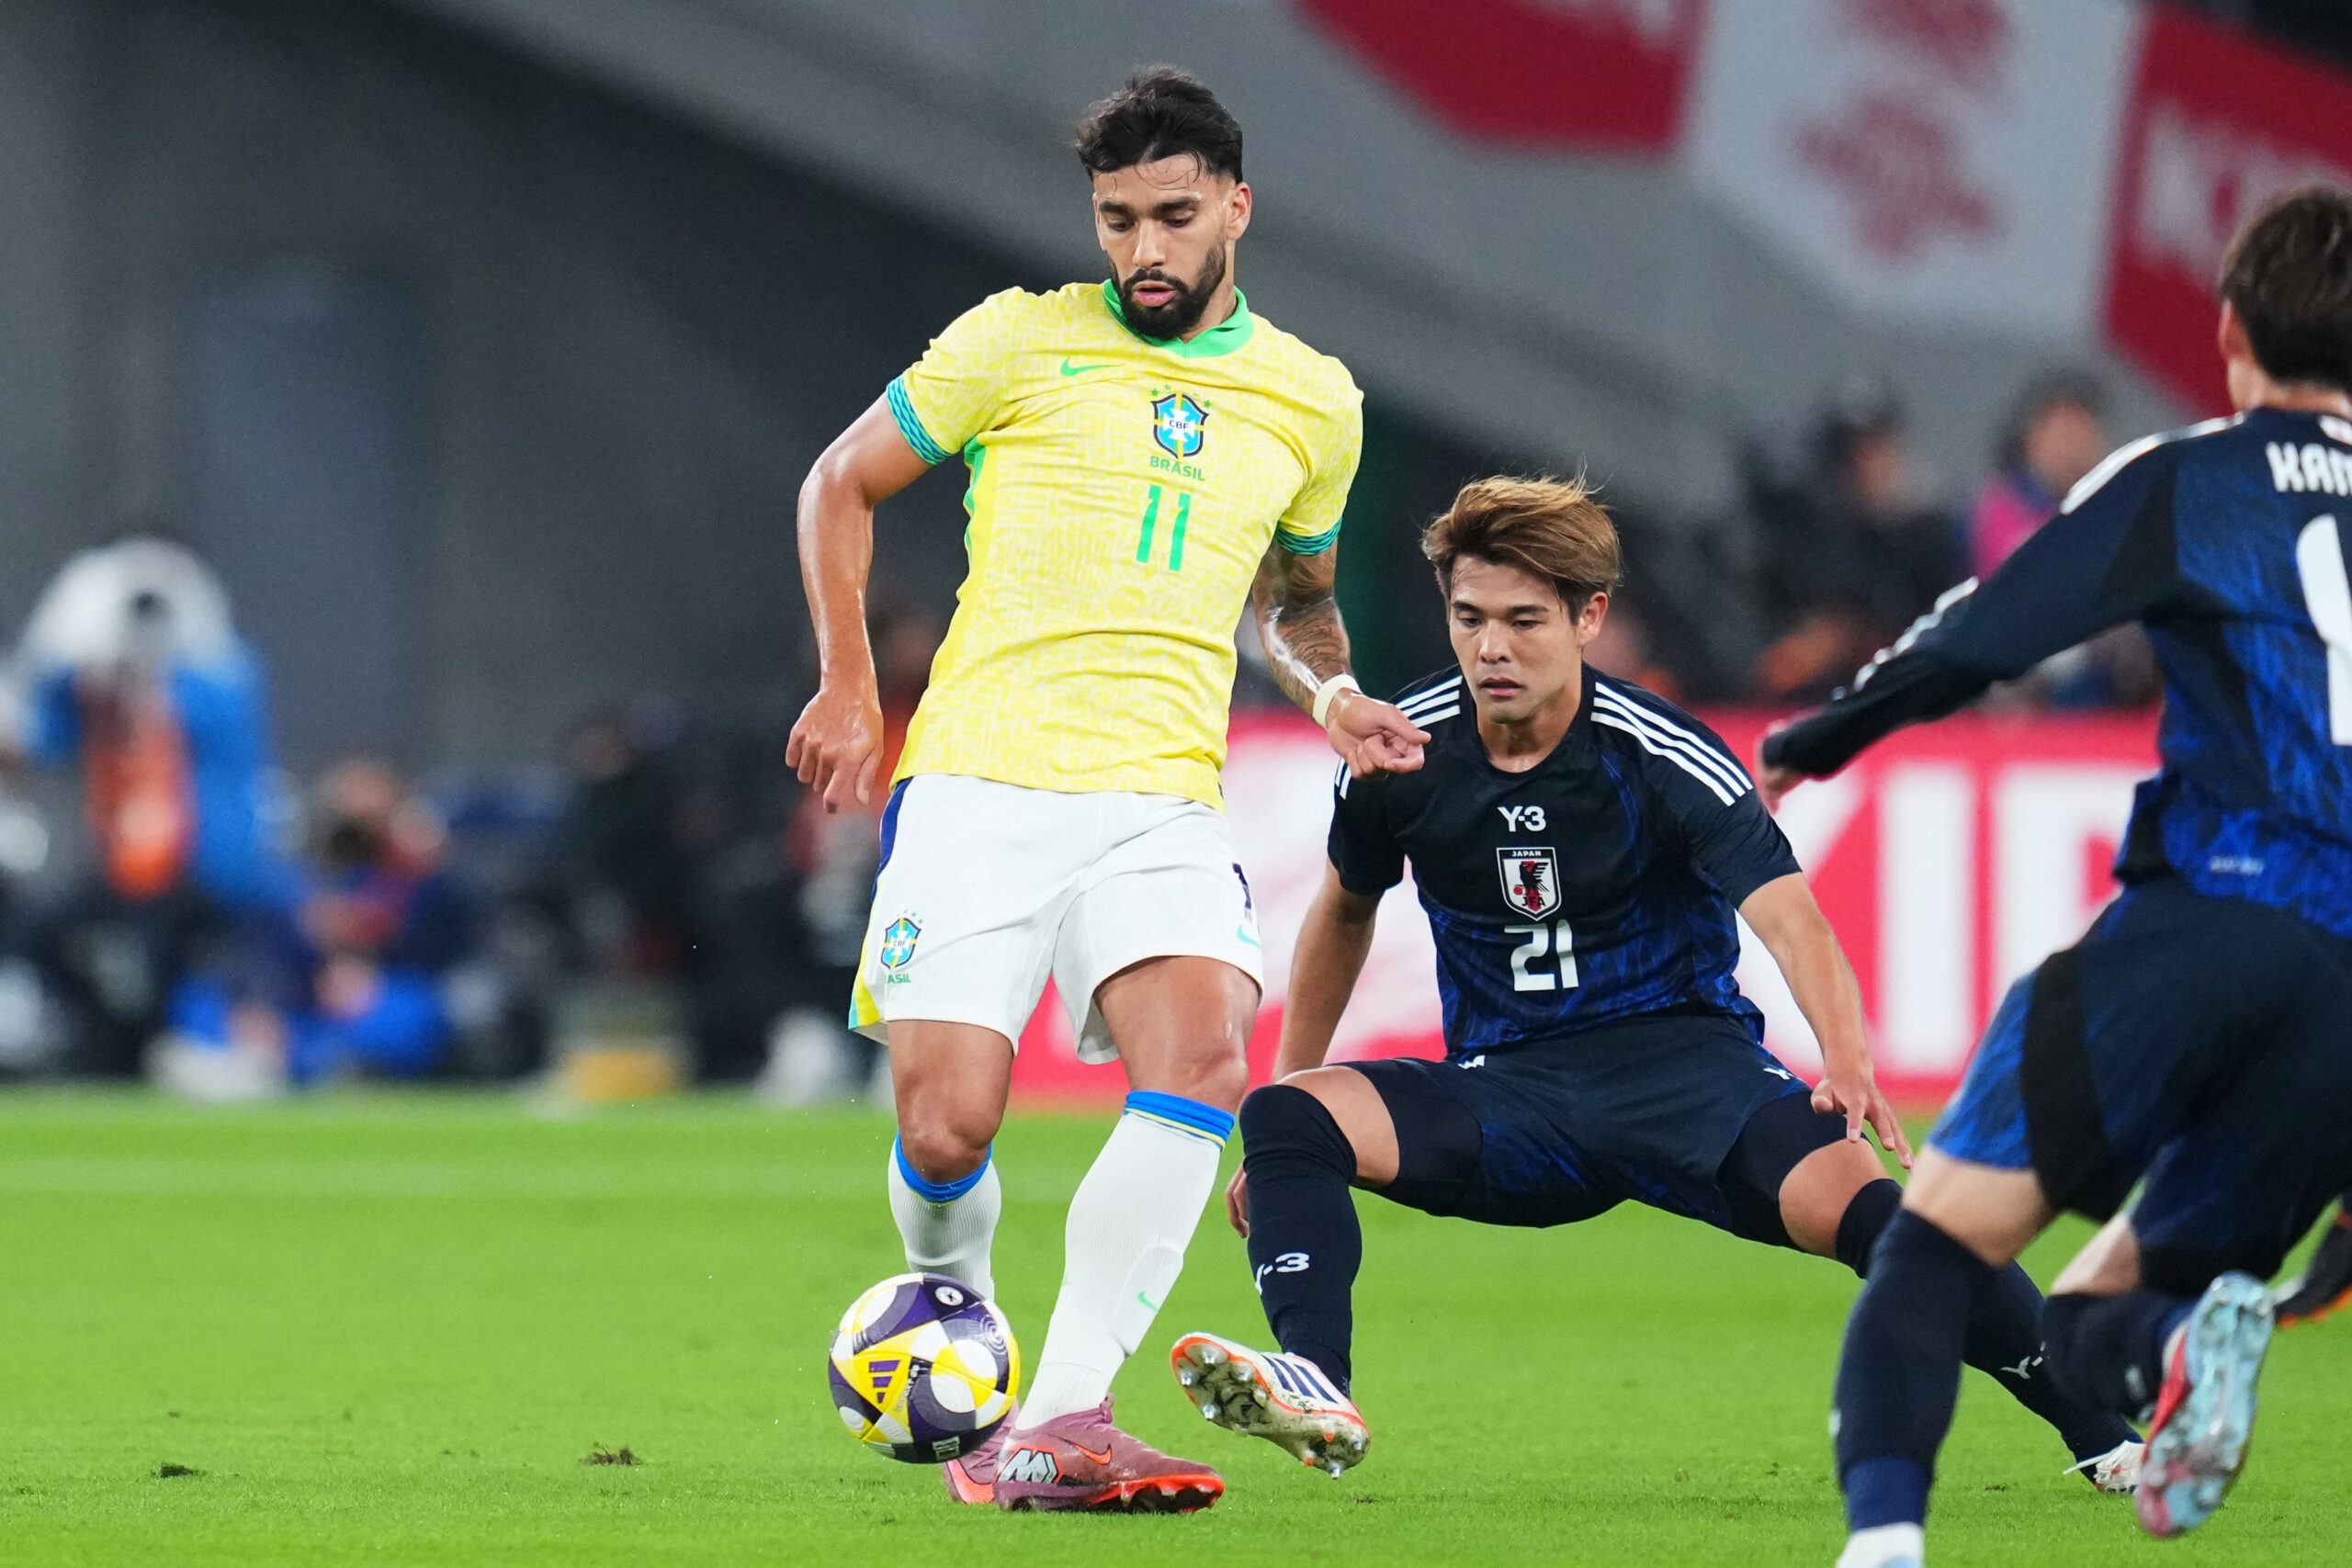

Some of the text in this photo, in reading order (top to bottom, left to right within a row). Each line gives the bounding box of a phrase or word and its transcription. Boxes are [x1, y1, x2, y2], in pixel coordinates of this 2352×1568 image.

[1169, 419, 1190, 430] CBF
[1149, 455, 1206, 481] BRASIL
[1136, 484, 1192, 572] 11
[1497, 806, 1547, 832] Y-3
[1521, 896, 1546, 907] JFA
[1504, 919, 1579, 991] 21
[887, 973, 912, 985] ASIL
